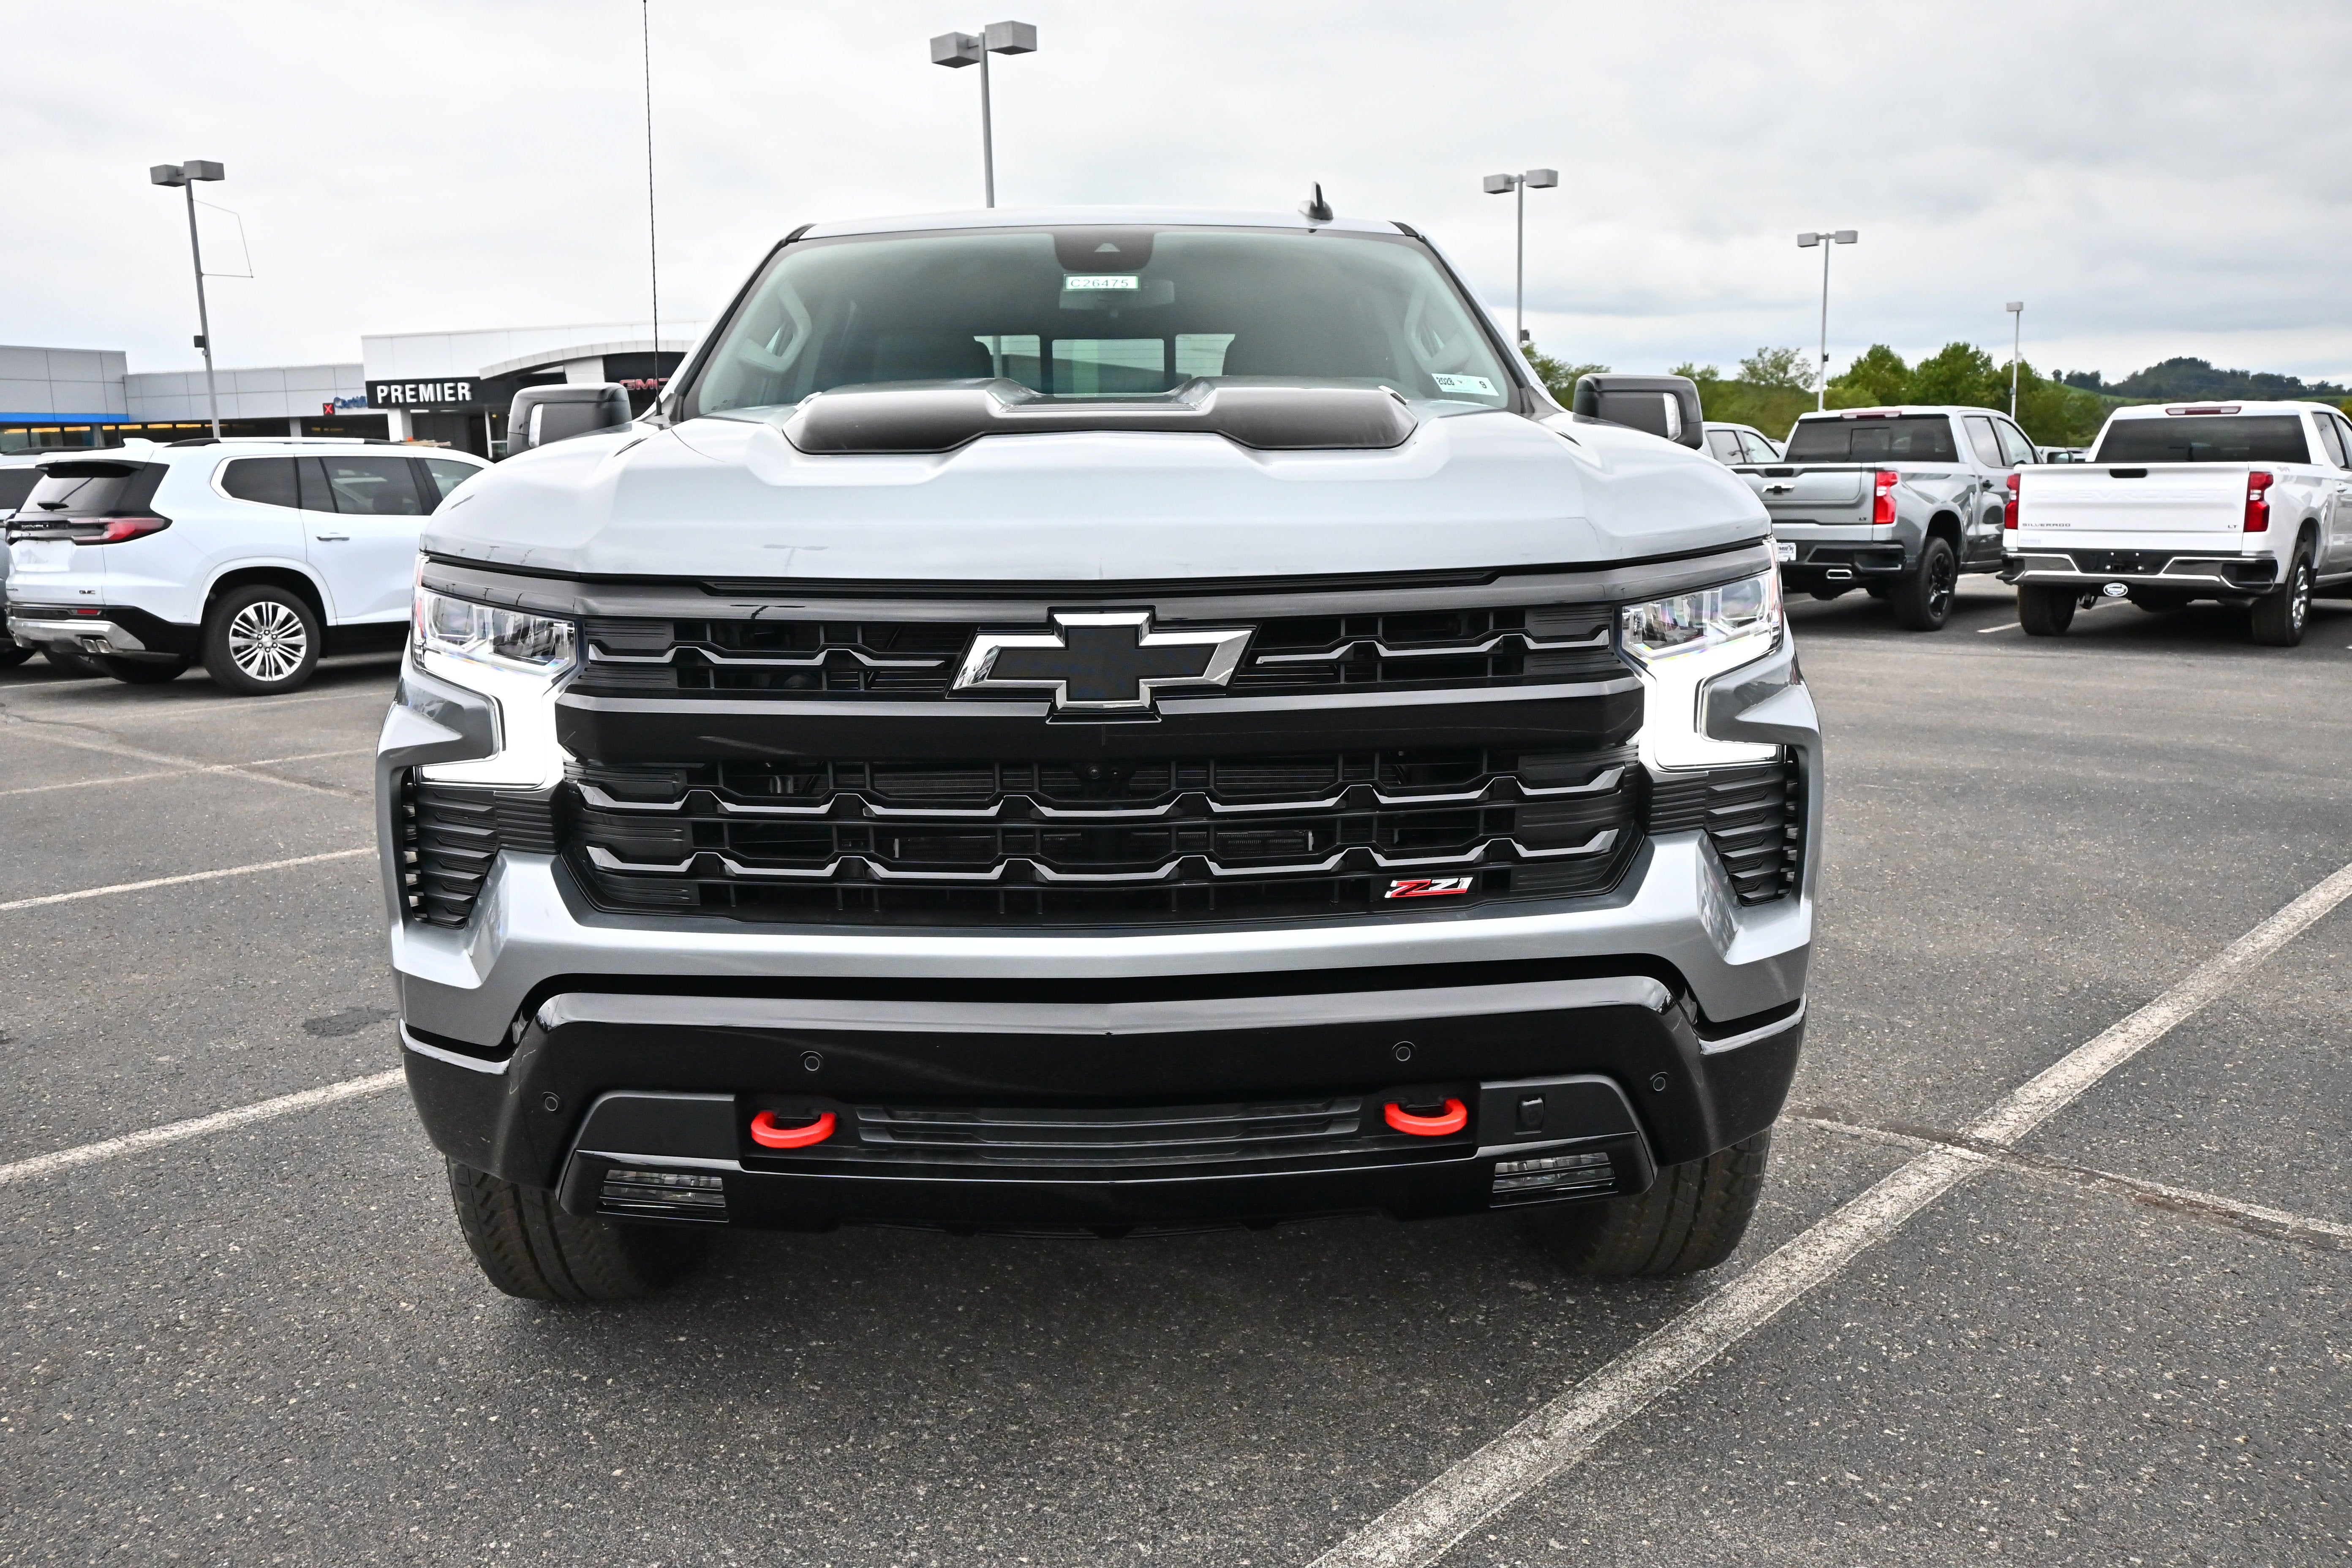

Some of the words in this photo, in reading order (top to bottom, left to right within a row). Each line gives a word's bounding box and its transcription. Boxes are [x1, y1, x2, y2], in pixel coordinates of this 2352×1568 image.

[1070, 279, 1129, 287] C26475
[619, 378, 670, 390] GMC
[1436, 377, 1455, 386] 2028
[1479, 381, 1487, 389] 9
[377, 382, 472, 404] PREMIER
[1384, 877, 1473, 898] Z71
